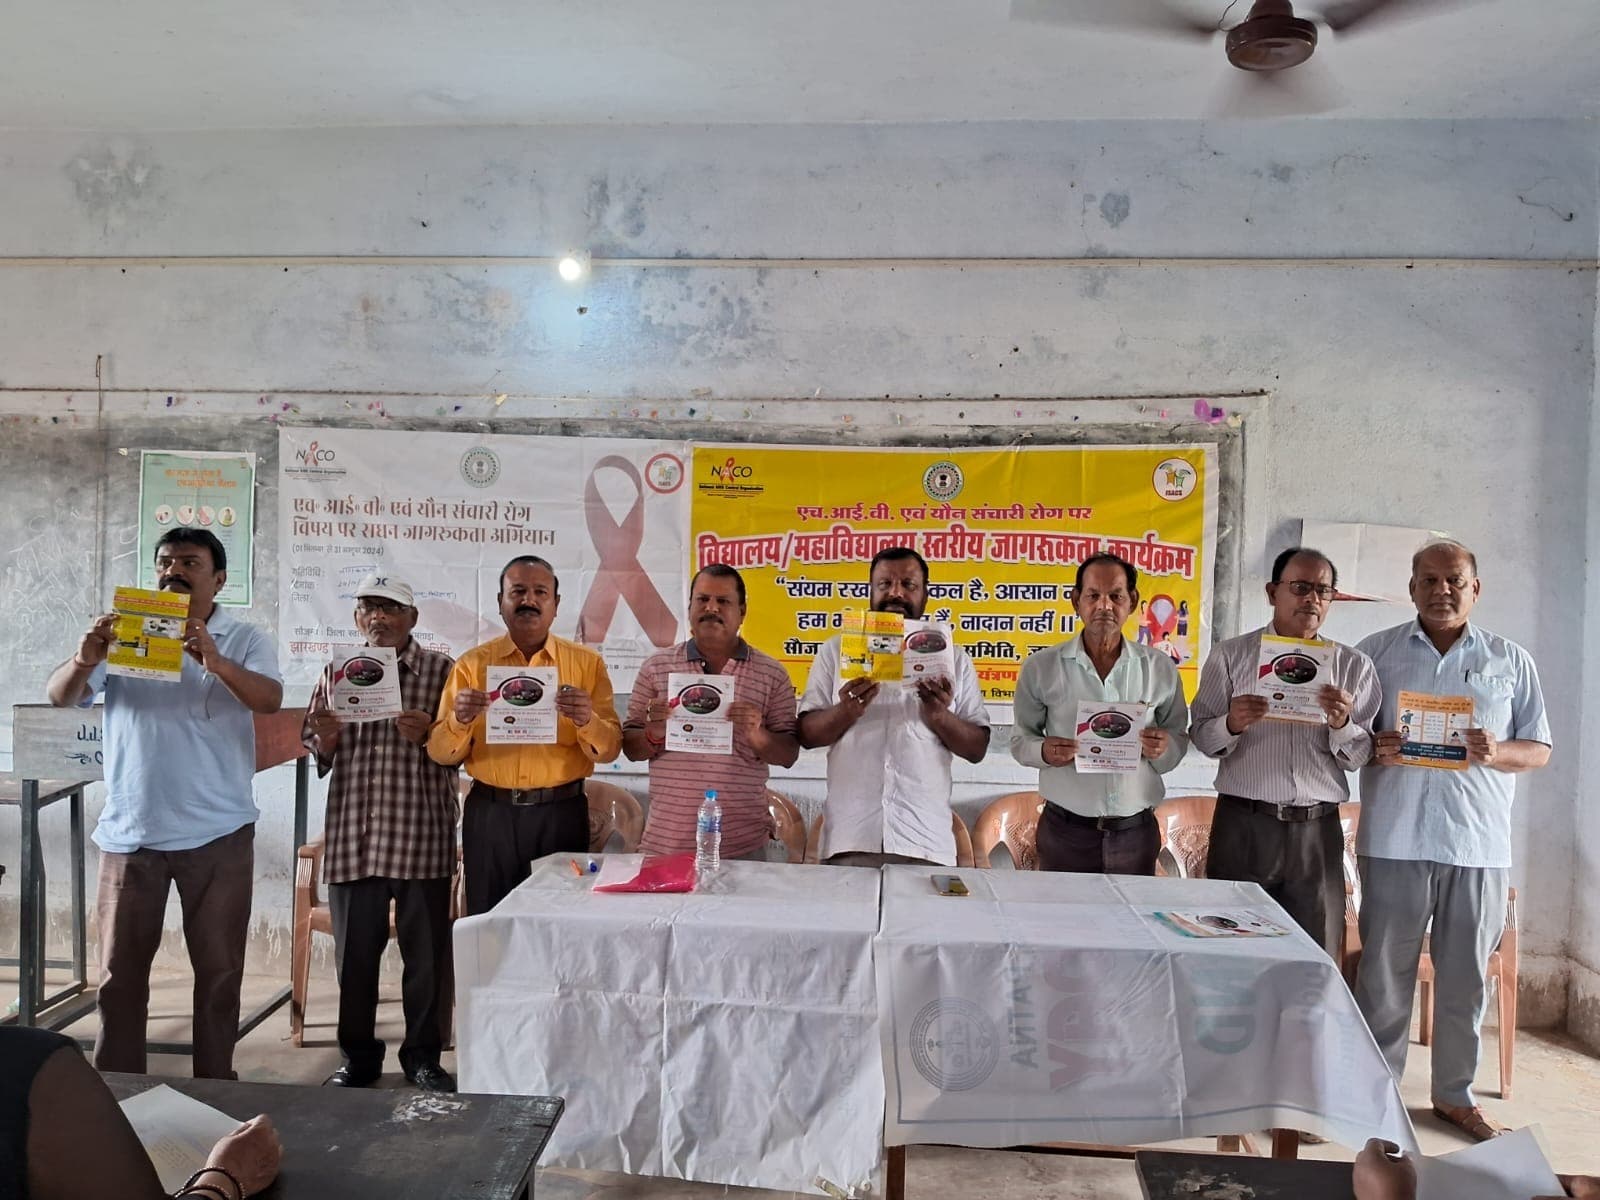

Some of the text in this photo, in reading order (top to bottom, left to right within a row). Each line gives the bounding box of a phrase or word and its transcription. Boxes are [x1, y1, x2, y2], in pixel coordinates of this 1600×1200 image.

[900, 503, 925, 522] एवं
[930, 503, 966, 520] यौन
[971, 503, 1025, 520] संचारी
[1030, 503, 1063, 520] रोग
[1068, 508, 1092, 520] पर
[922, 523, 986, 559] स्तरीय
[838, 582, 870, 598] रख
[995, 584, 1057, 600] आसान
[797, 612, 827, 629] हम
[960, 615, 1014, 631] नादान
[1019, 610, 1055, 632] नहीं
[784, 638, 823, 655] सौज
[976, 667, 1018, 682] यंत्रण
[991, 687, 1015, 697] विभा
